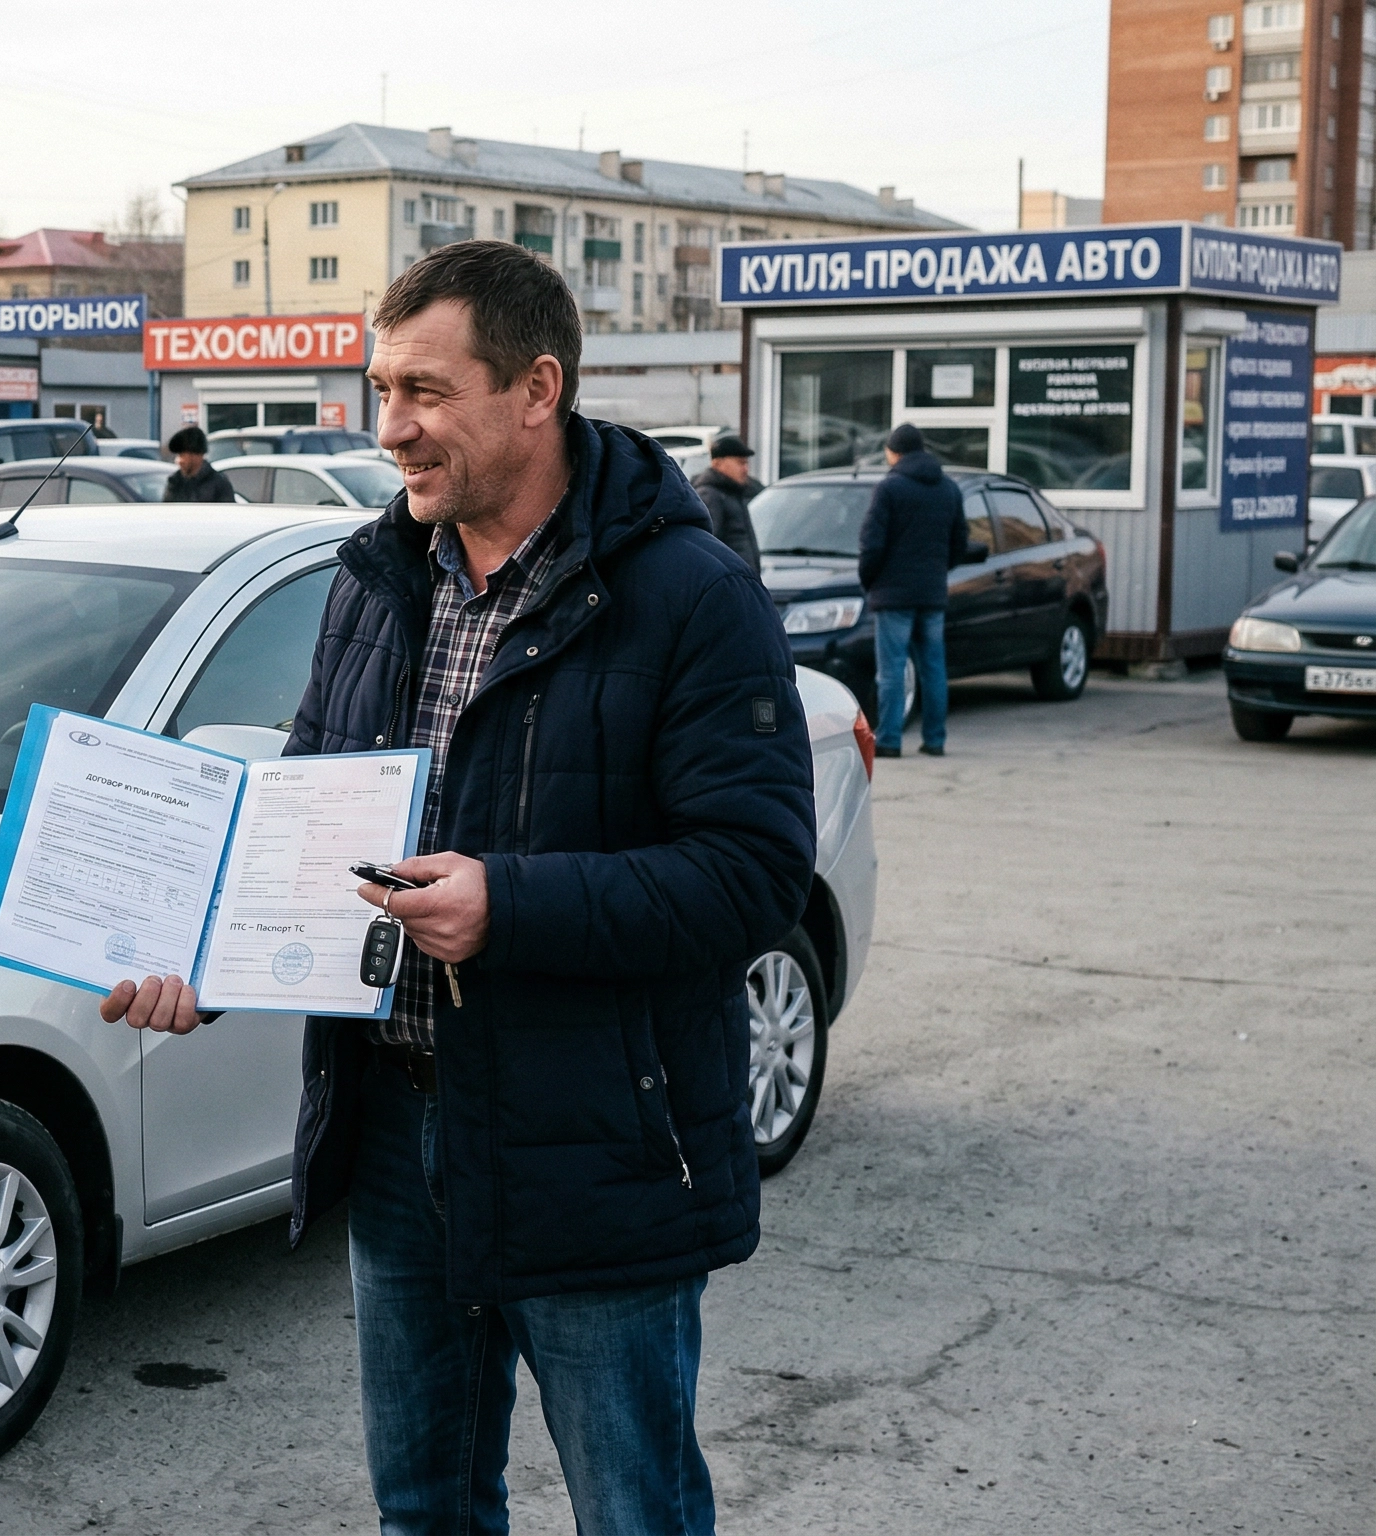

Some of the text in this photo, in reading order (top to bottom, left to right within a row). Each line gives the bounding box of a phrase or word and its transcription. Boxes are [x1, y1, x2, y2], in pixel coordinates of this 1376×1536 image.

[739, 236, 1162, 295] КУПЛЯ-ПРОДАЖА АВТО
[1192, 237, 1339, 294] КУПЛЯ-ПРОДАЖА АВТО
[149, 322, 359, 362] ТЕХОСМОТР
[261, 771, 282, 782] ПТС
[229, 922, 247, 931] ПТС
[256, 923, 292, 934] Паспорт
[294, 924, 306, 933] ТС
